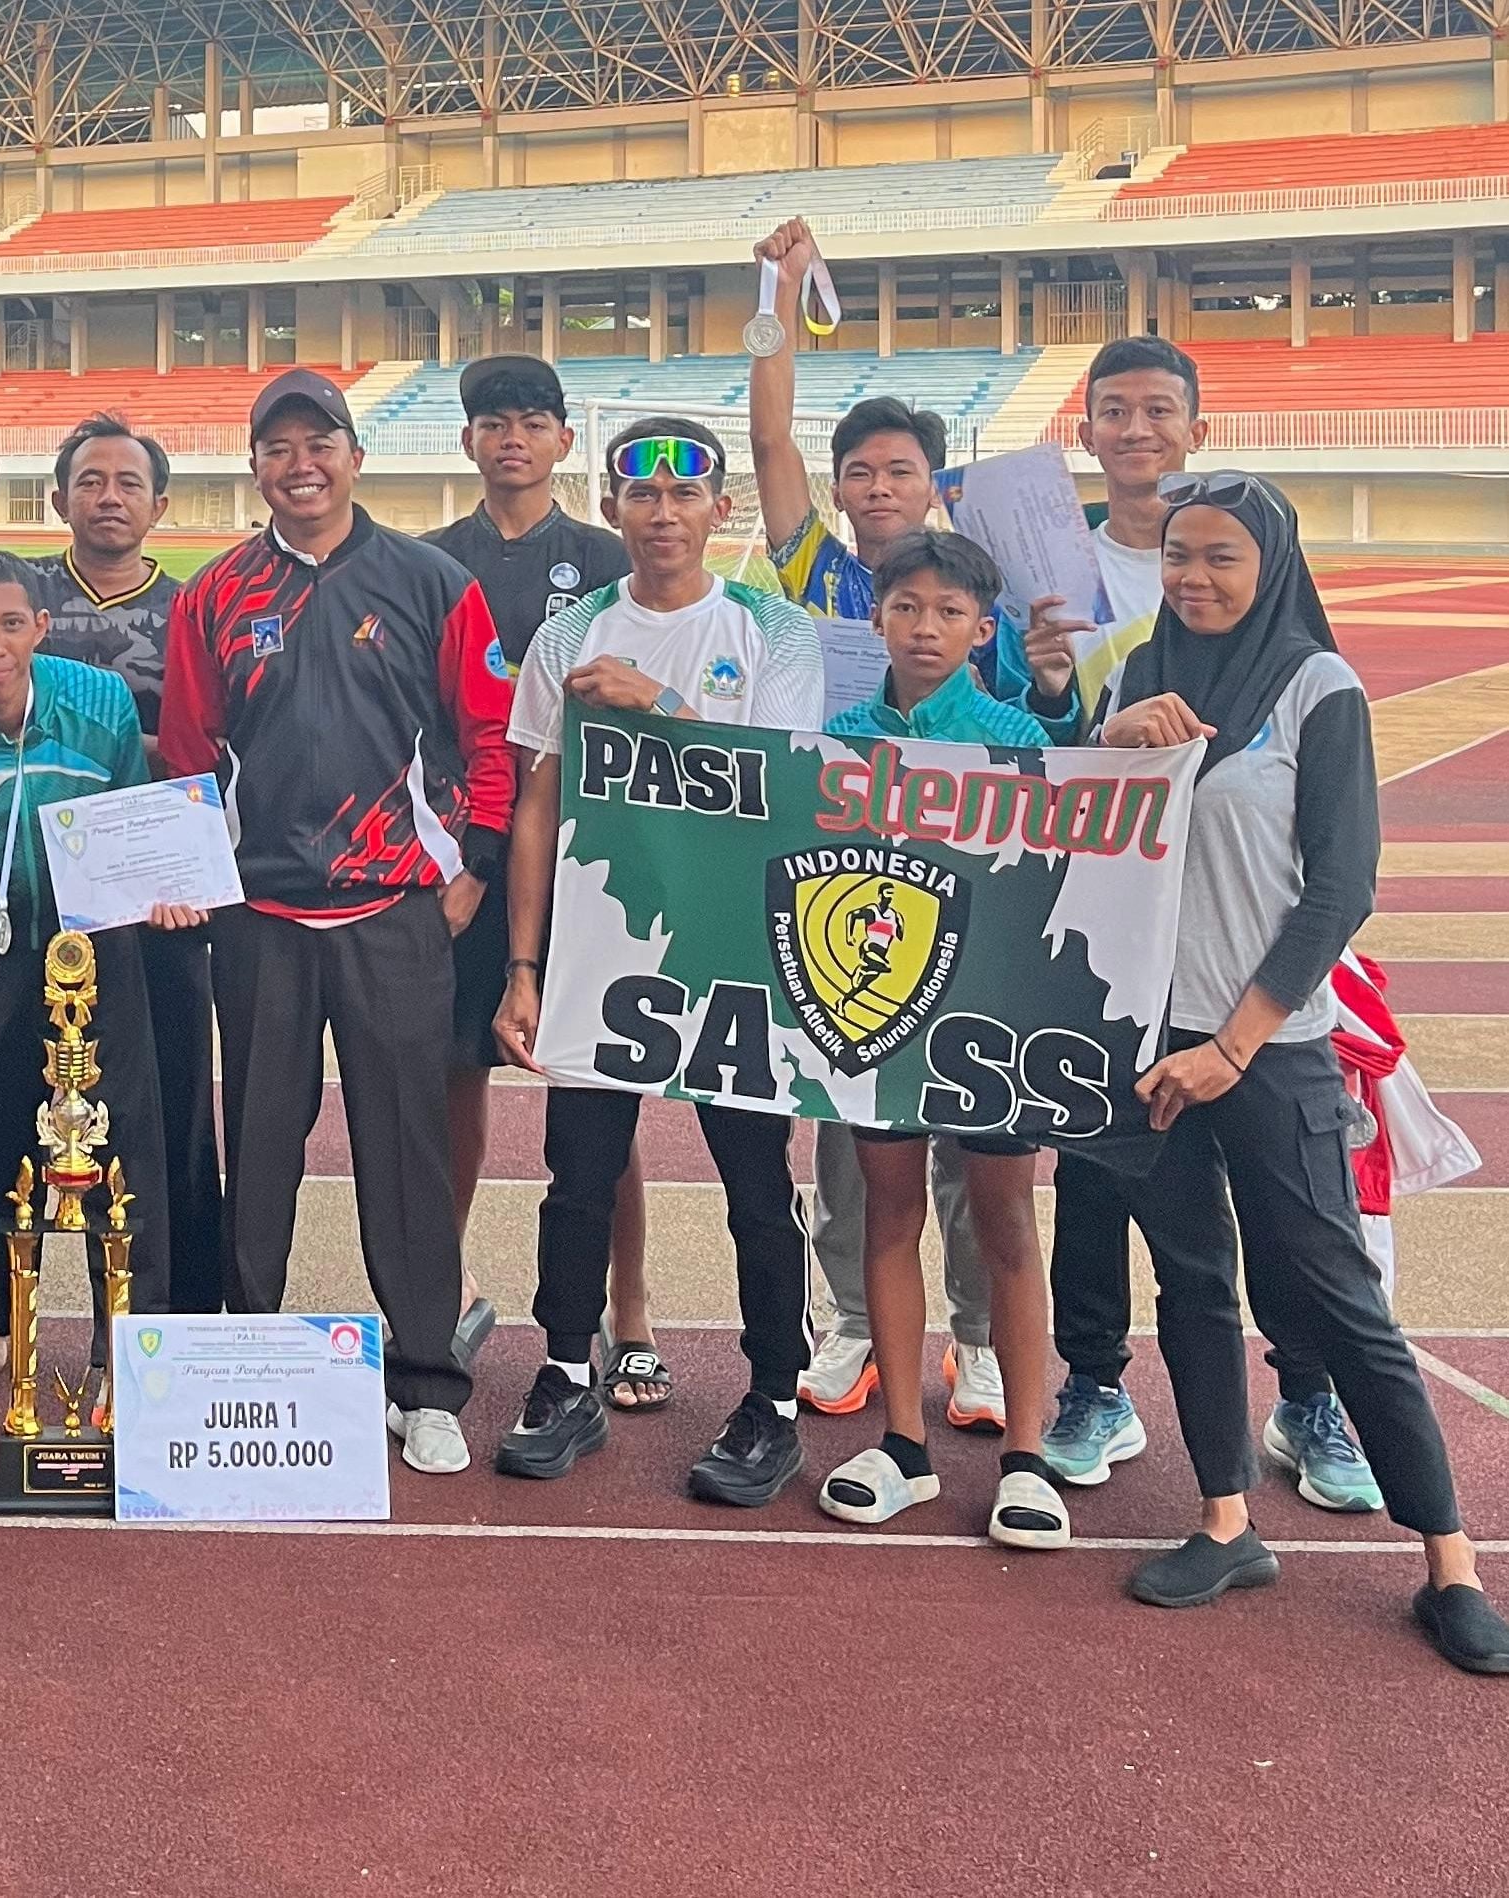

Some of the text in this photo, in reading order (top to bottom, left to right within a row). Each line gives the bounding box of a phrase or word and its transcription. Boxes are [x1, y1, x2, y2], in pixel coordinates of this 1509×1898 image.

[580, 722, 769, 820] PASI
[783, 848, 957, 898] INDONESIA
[773, 911, 959, 1063] Persatuan Atletik Seluruh Indonesia
[204, 1401, 298, 1430] JUARA 1
[35, 1452, 69, 1461] JUARA
[70, 1452, 100, 1461] UMUM
[169, 1440, 334, 1469] RP 5.000.000
